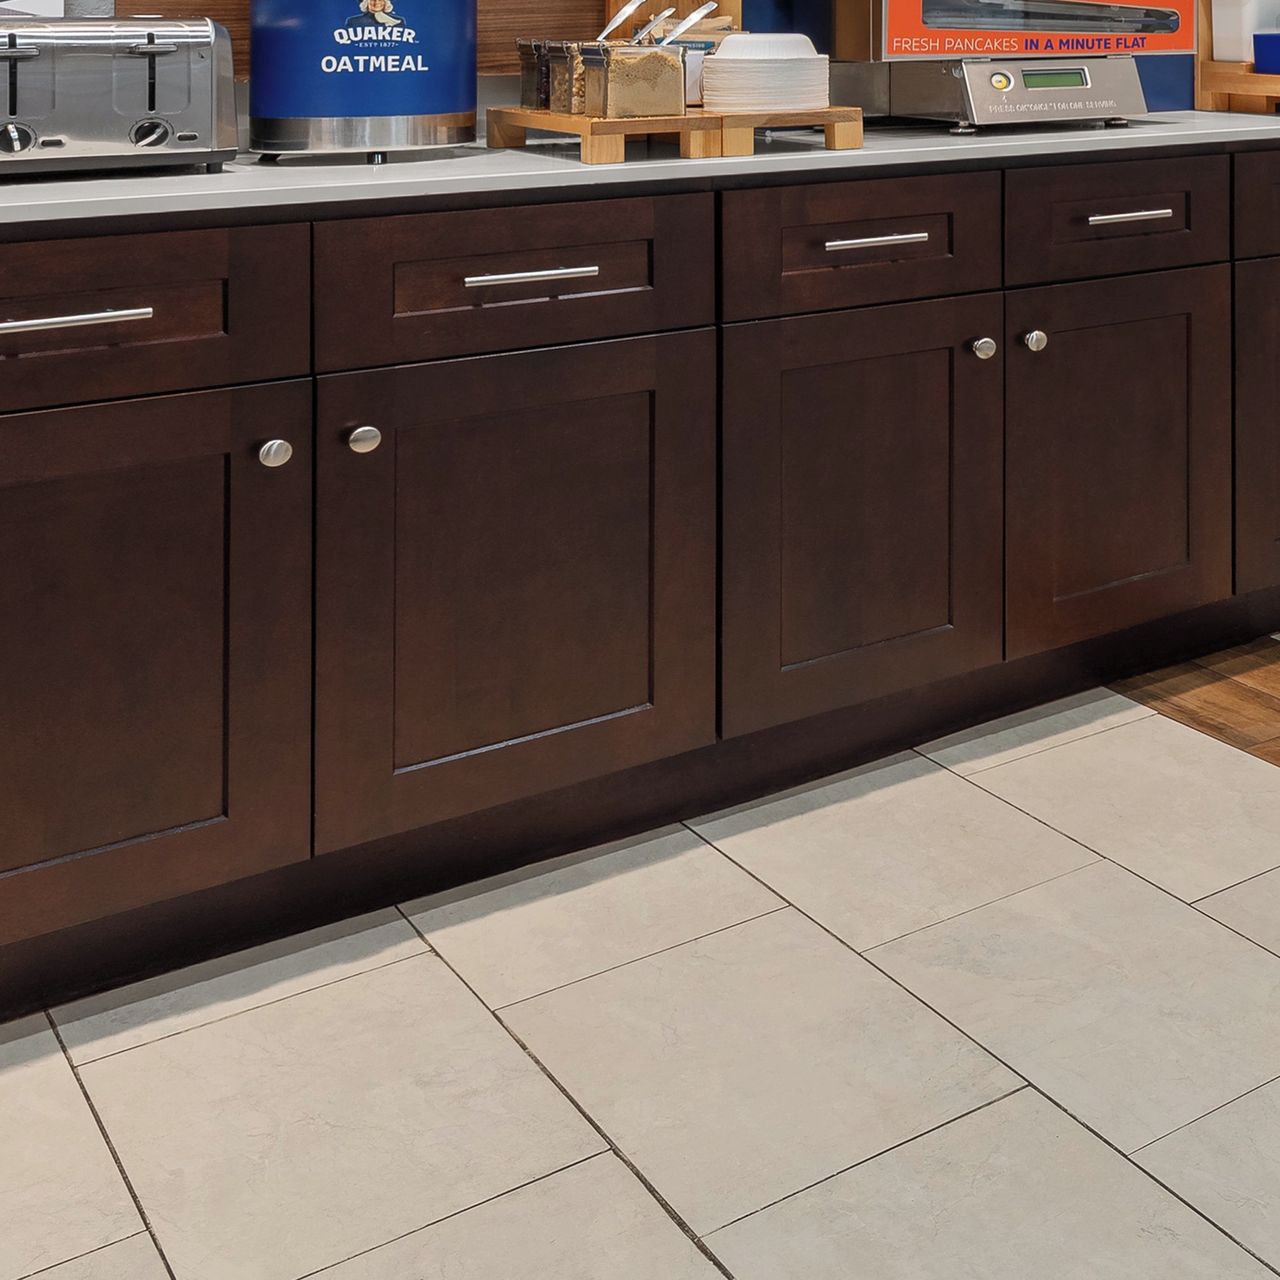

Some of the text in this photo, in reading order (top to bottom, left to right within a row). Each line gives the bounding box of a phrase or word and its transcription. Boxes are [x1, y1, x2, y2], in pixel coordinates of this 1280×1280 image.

[333, 26, 416, 45] QUAKER
[893, 36, 1147, 52] FRESH PANCAKES IN A MINUTE FLAT
[321, 55, 429, 72] OATMEAL
